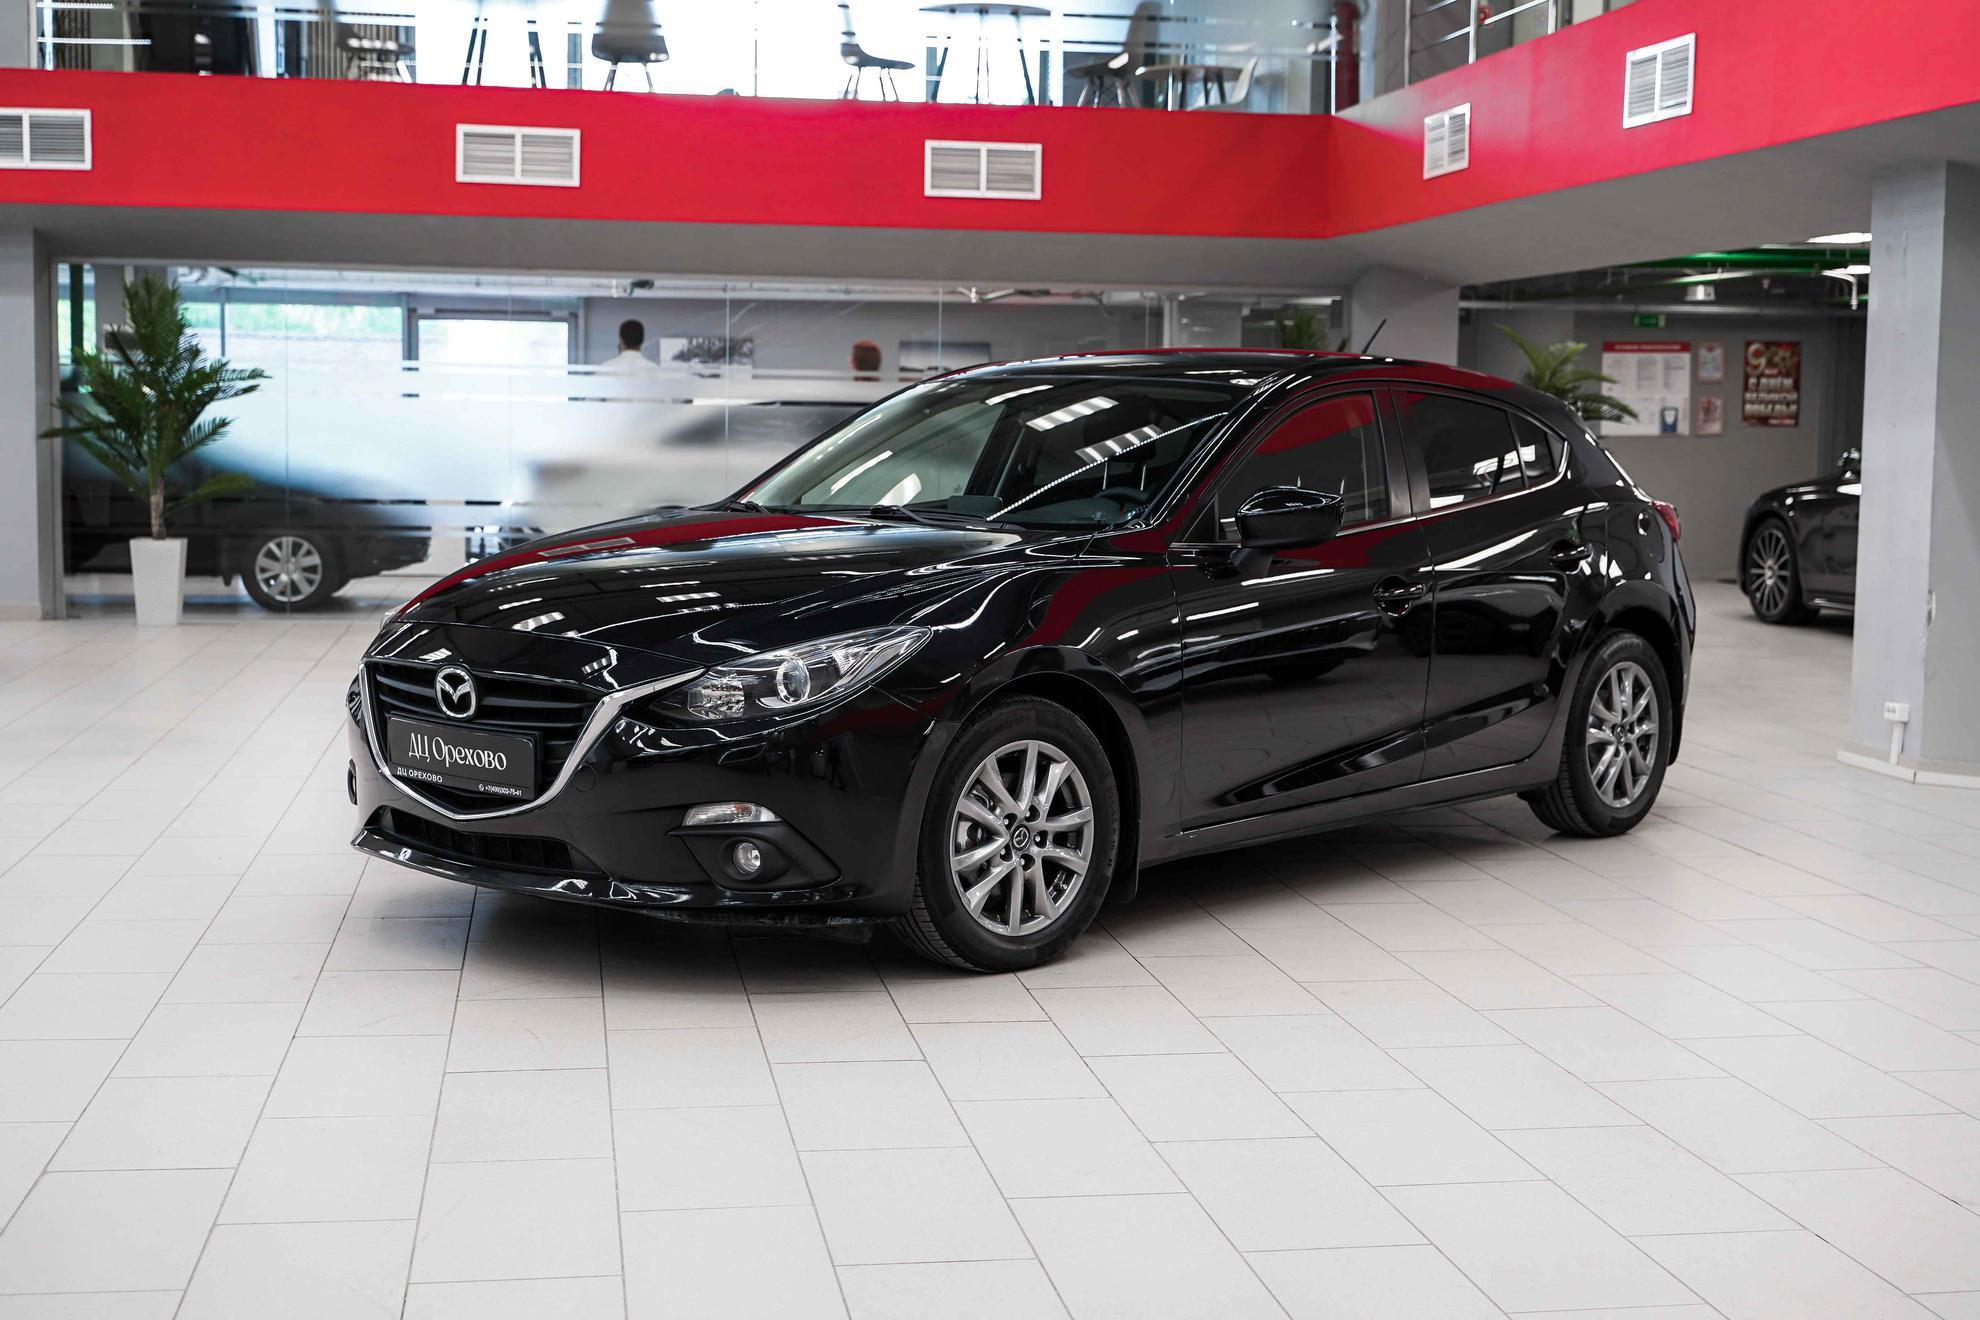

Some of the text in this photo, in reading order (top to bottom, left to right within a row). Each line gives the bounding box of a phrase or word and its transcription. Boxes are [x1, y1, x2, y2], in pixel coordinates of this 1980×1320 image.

[408, 732, 506, 770] ДЦ Орехово
[397, 767, 442, 783] ДЦ ОРЕХОВО
